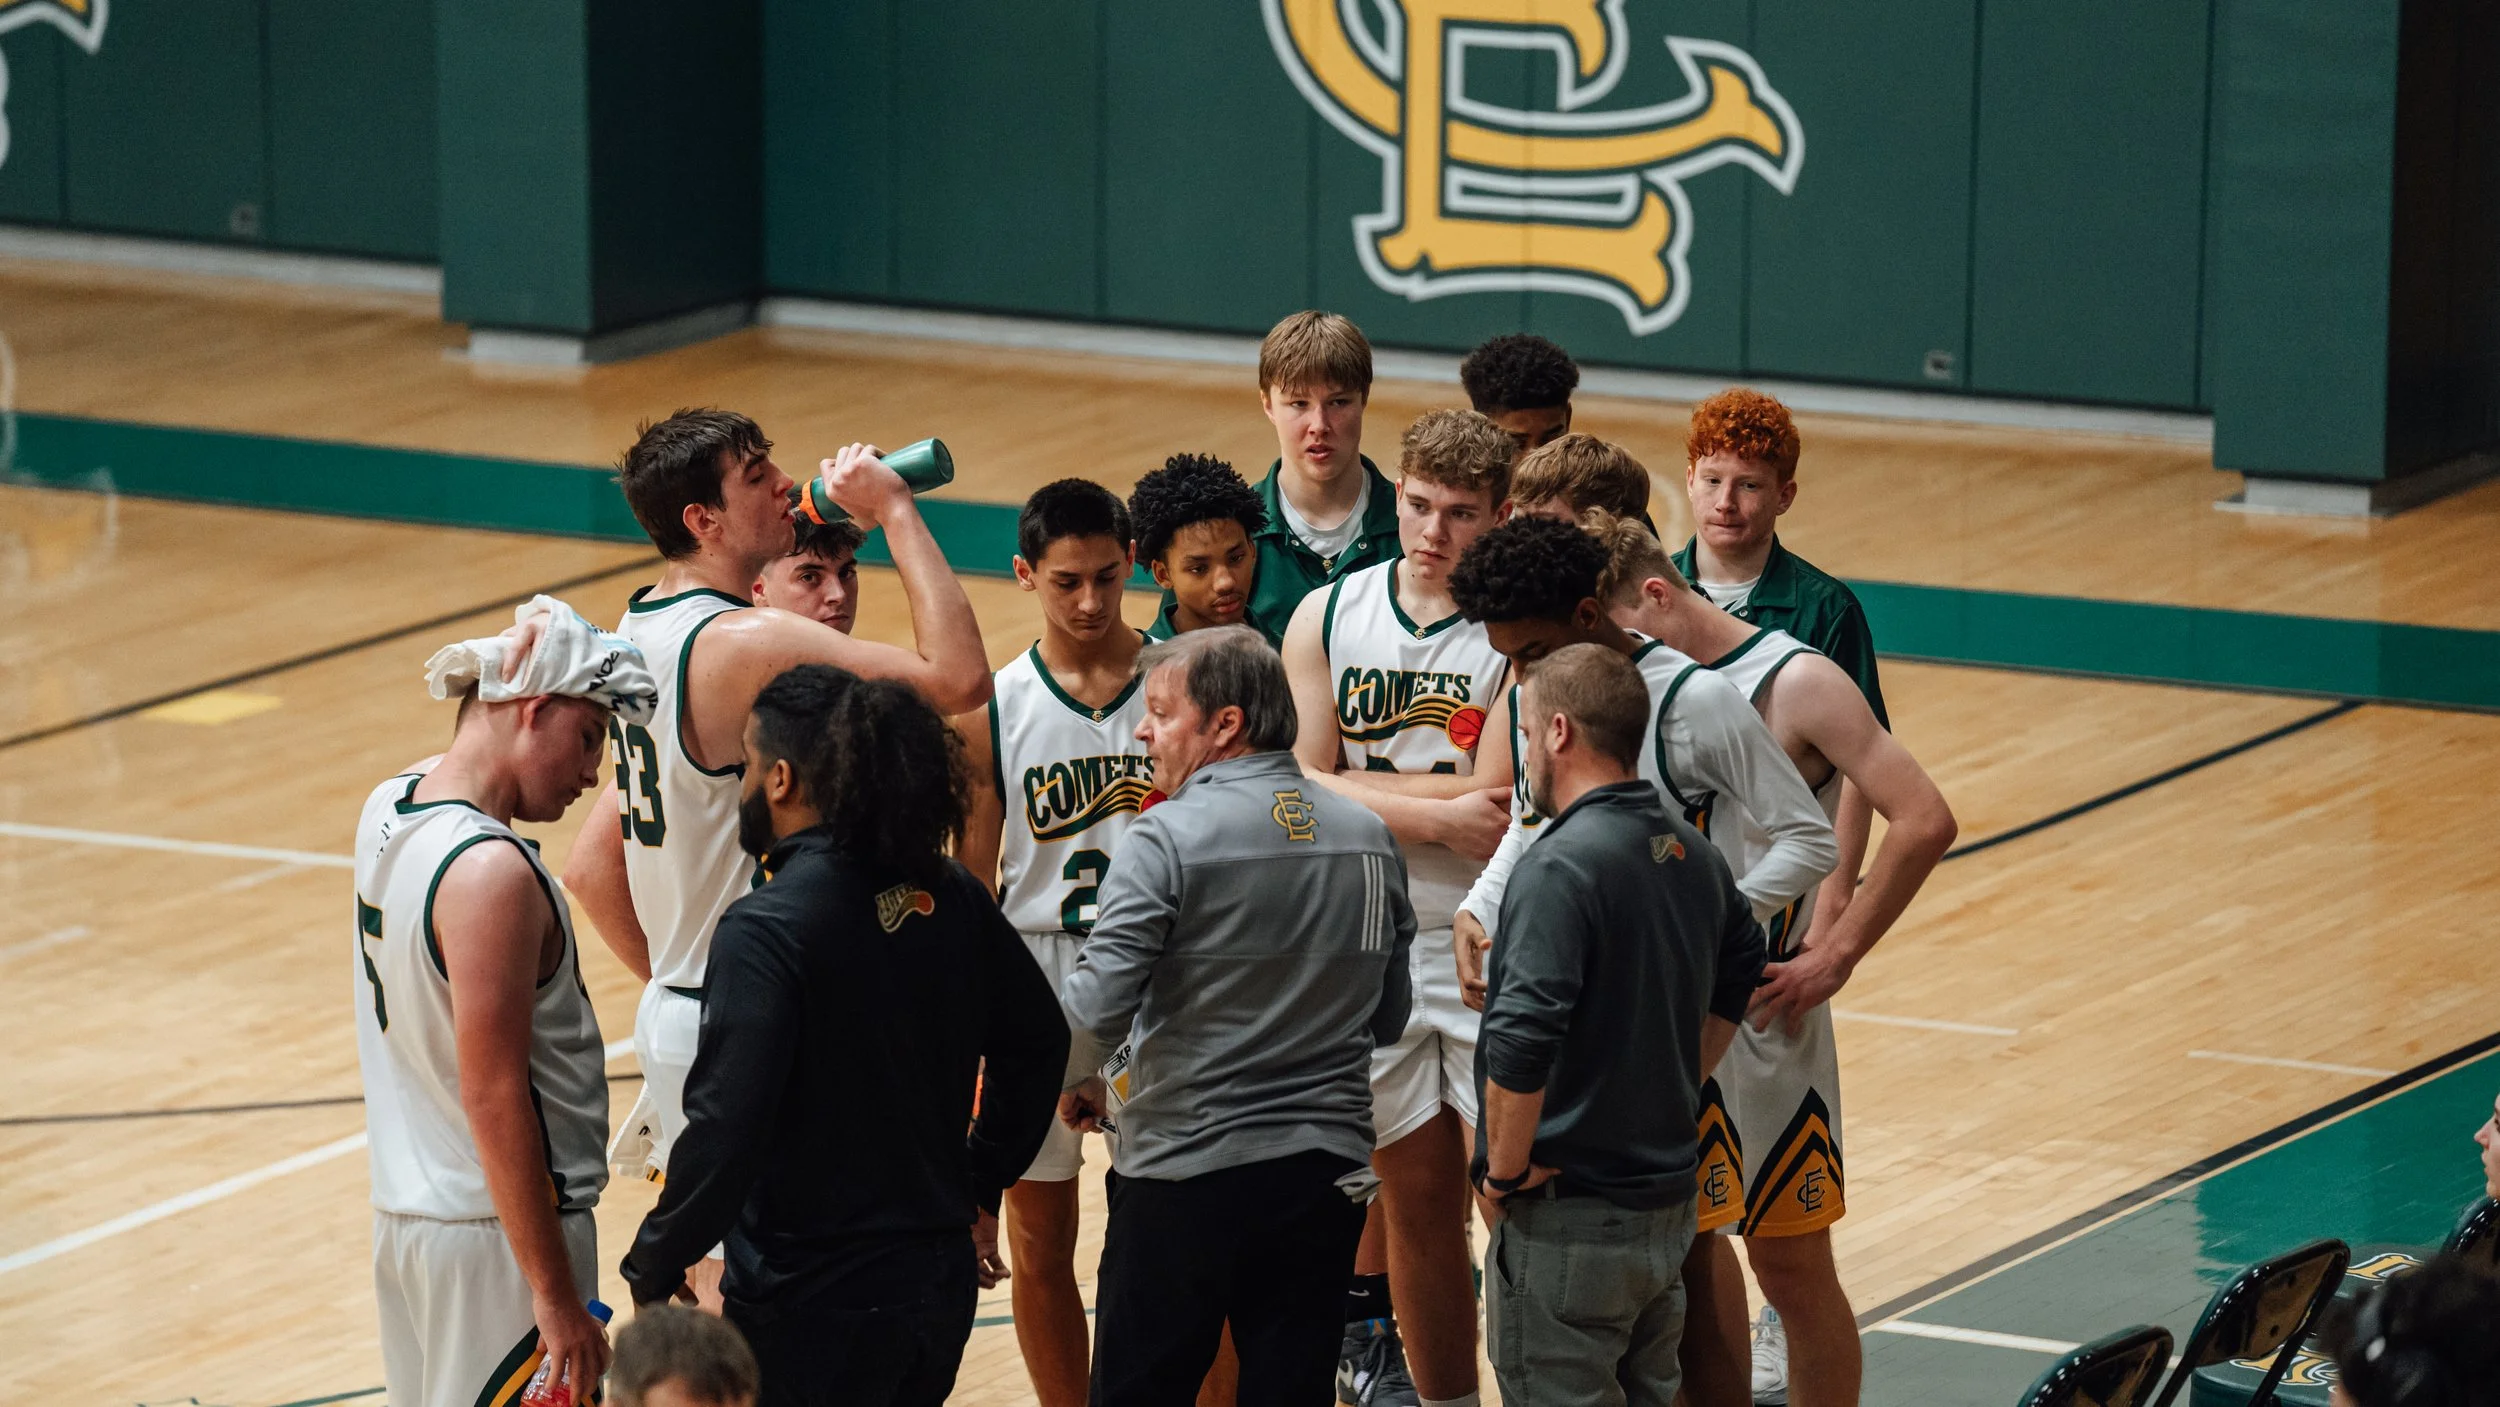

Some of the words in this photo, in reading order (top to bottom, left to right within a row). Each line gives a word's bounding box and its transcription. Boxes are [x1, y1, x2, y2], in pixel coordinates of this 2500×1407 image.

[1337, 666, 1472, 727] COMETS
[608, 714, 667, 849] 33
[1060, 848, 1112, 929] 2
[357, 891, 389, 1033] 5
